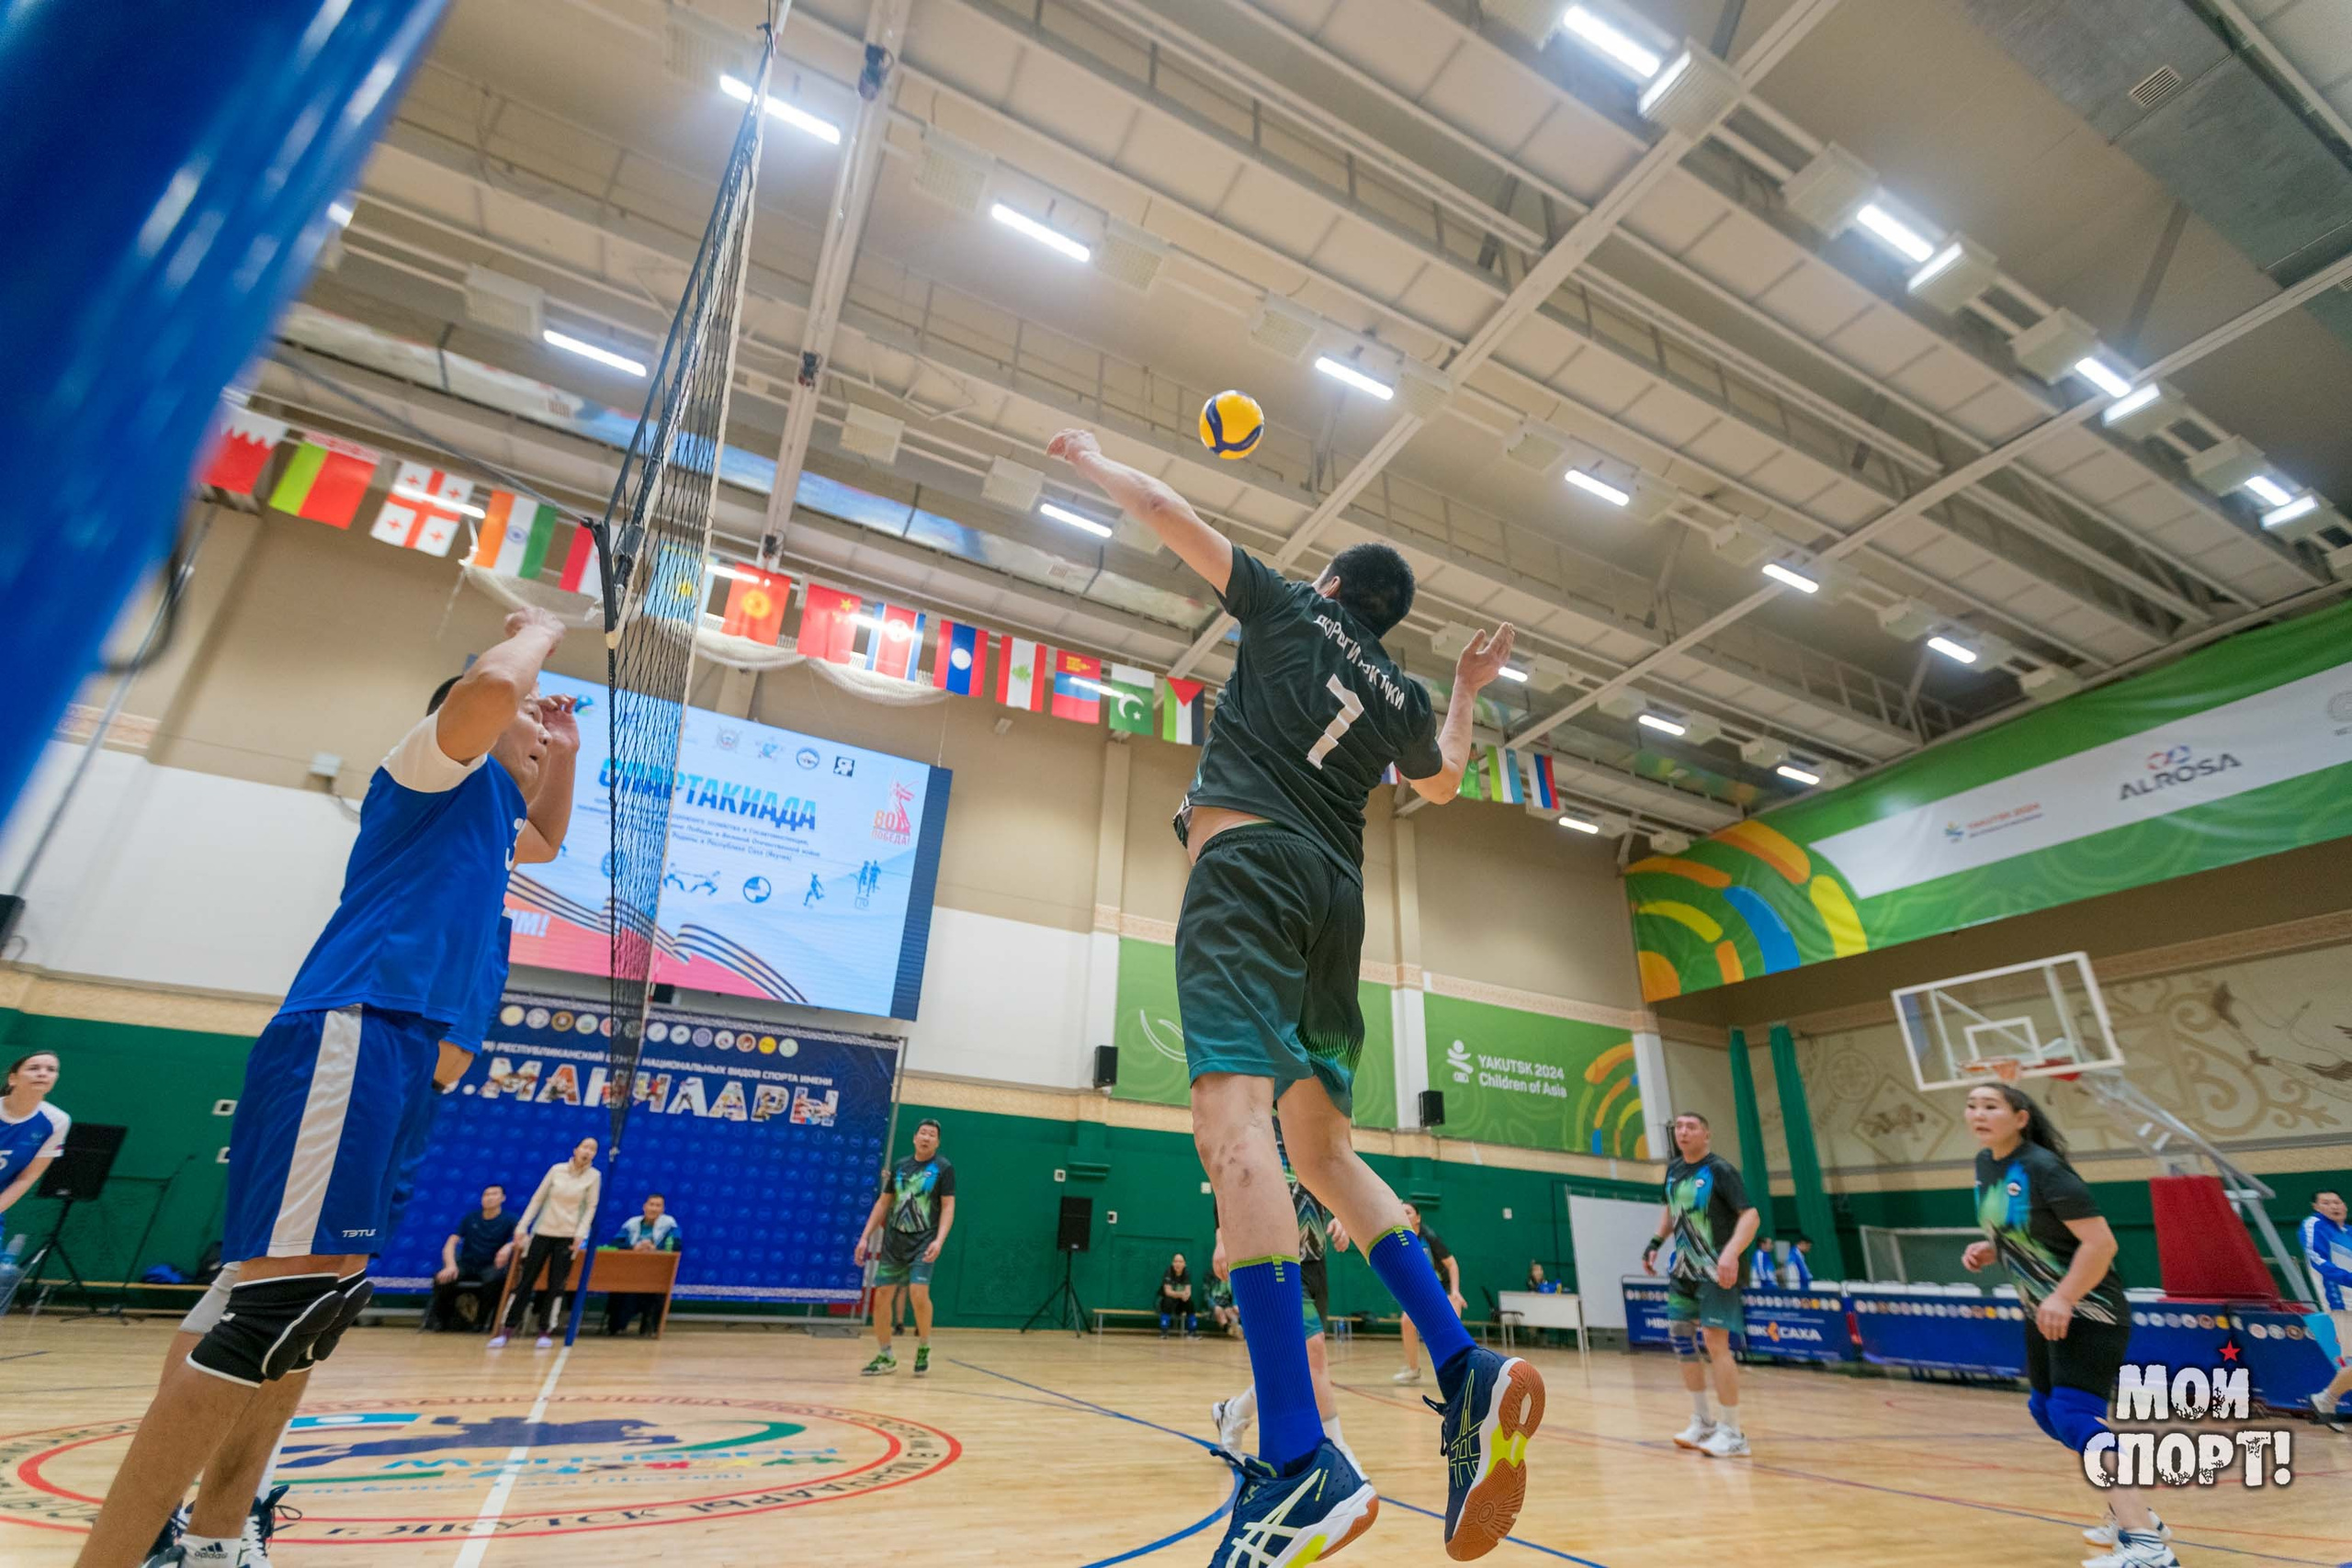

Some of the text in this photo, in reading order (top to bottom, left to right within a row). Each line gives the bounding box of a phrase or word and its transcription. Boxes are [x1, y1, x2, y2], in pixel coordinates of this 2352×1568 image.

[1306, 673, 1365, 771] 7
[2119, 752, 2242, 800] ALROSA
[496, 1041, 605, 1062] РЕСПУБЛИКАНСКИЙ
[762, 1070, 797, 1083] СПОРТА
[798, 1074, 832, 1086] ИМЕНИ
[1477, 1054, 1565, 1080] YAKUTSK 2024
[1478, 1071, 1567, 1099] Children of Asia
[1780, 1327, 1823, 1342] САХА
[194, 1550, 228, 1560] adidas
